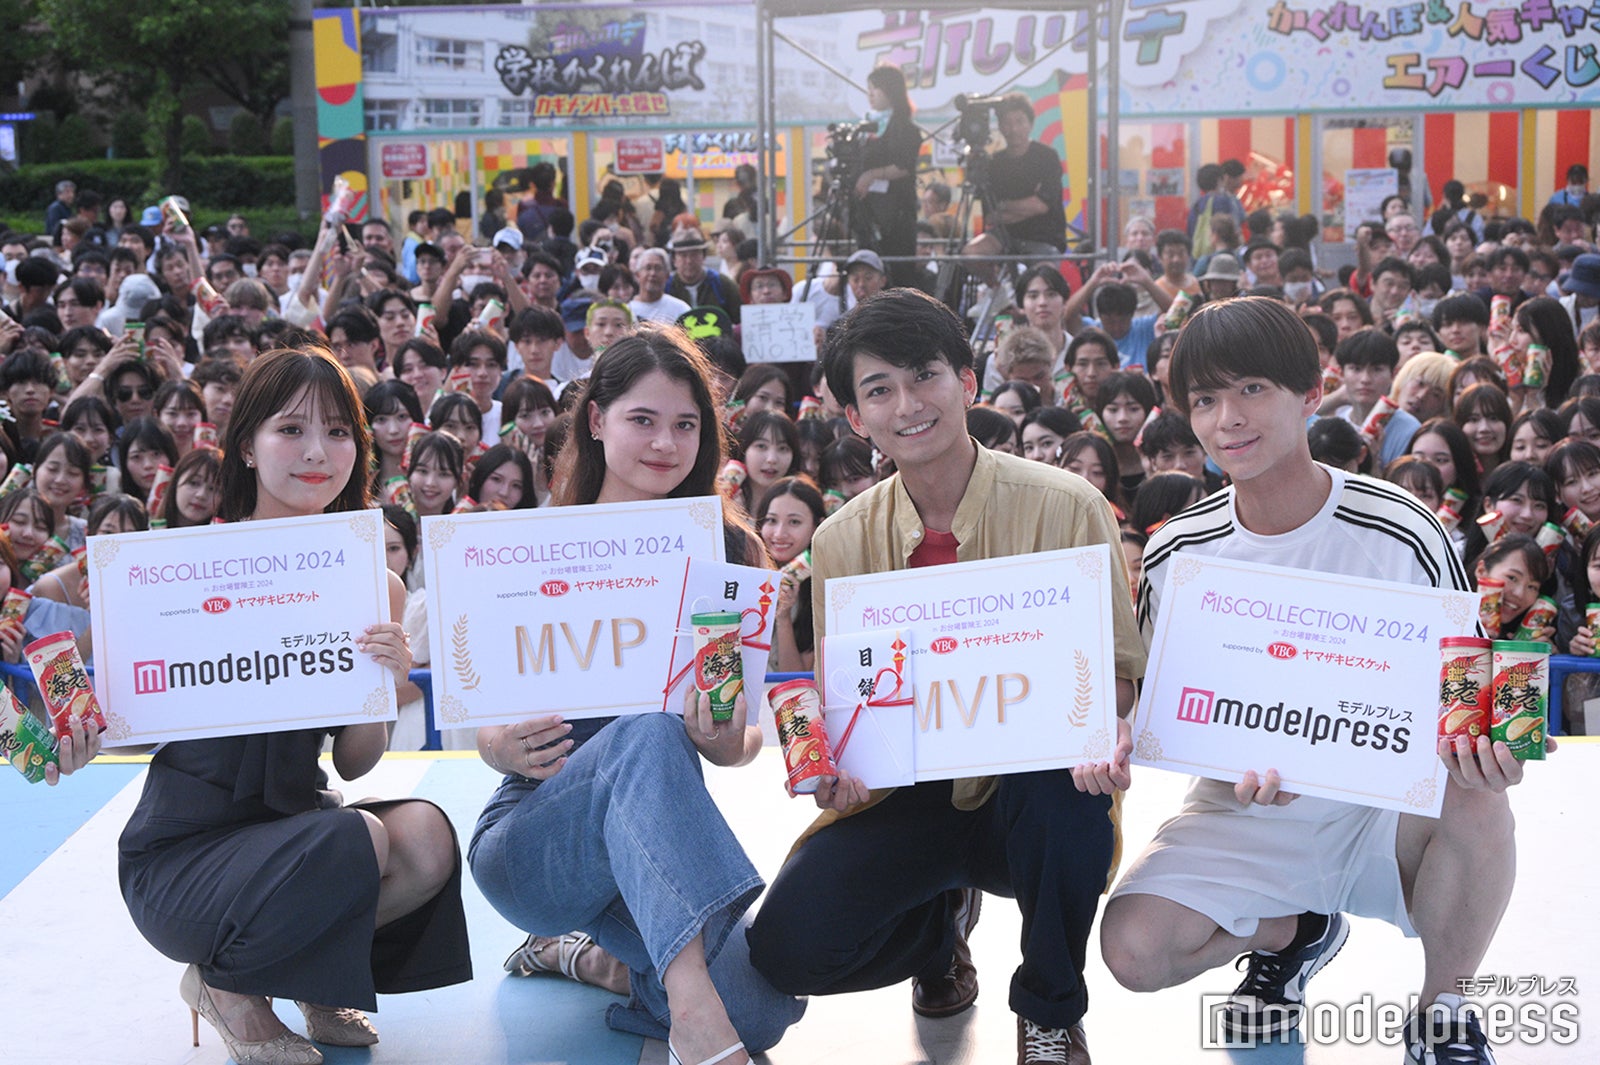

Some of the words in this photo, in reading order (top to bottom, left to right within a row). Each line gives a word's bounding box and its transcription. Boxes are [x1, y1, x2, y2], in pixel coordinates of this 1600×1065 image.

[497, 41, 706, 96] 学校かくれんぼ
[1383, 43, 1600, 97] エアーくじ
[534, 93, 668, 117] カギメンバーを探せ
[464, 539, 627, 568] MISCOLLECTION
[634, 535, 685, 556] 2024
[128, 554, 288, 586] MISCOLLECTION
[296, 549, 345, 571] 2024
[595, 564, 612, 572] 2024
[257, 580, 274, 588] 2024
[529, 590, 538, 598] by
[544, 582, 566, 595] YBC
[574, 576, 659, 592] ヤマザキビスケット
[206, 598, 228, 612] YBC
[236, 591, 319, 609] ヤマザキビスケット
[862, 593, 1014, 627] MISCOLLECTION
[1022, 586, 1071, 609] 2024
[1200, 591, 1367, 634] MISCOLLECTION
[1374, 619, 1429, 643] 2024
[281, 631, 351, 648] モデルプレス
[514, 617, 648, 675] MVP
[935, 640, 955, 652] YBC
[962, 629, 1044, 648] ヤマザキビスケット
[1328, 635, 1346, 645] 2024
[170, 647, 353, 689] modelpress
[703, 651, 741, 676] 海老
[1255, 647, 1263, 655] by
[1272, 643, 1294, 658] YBC
[1302, 649, 1391, 672] ヤマザキビスケット
[48, 668, 89, 699] 海老
[1494, 683, 1541, 712] 海老
[913, 673, 1031, 733] MVP
[1337, 700, 1413, 723] モデルプレス
[1213, 697, 1411, 754] modelpress
